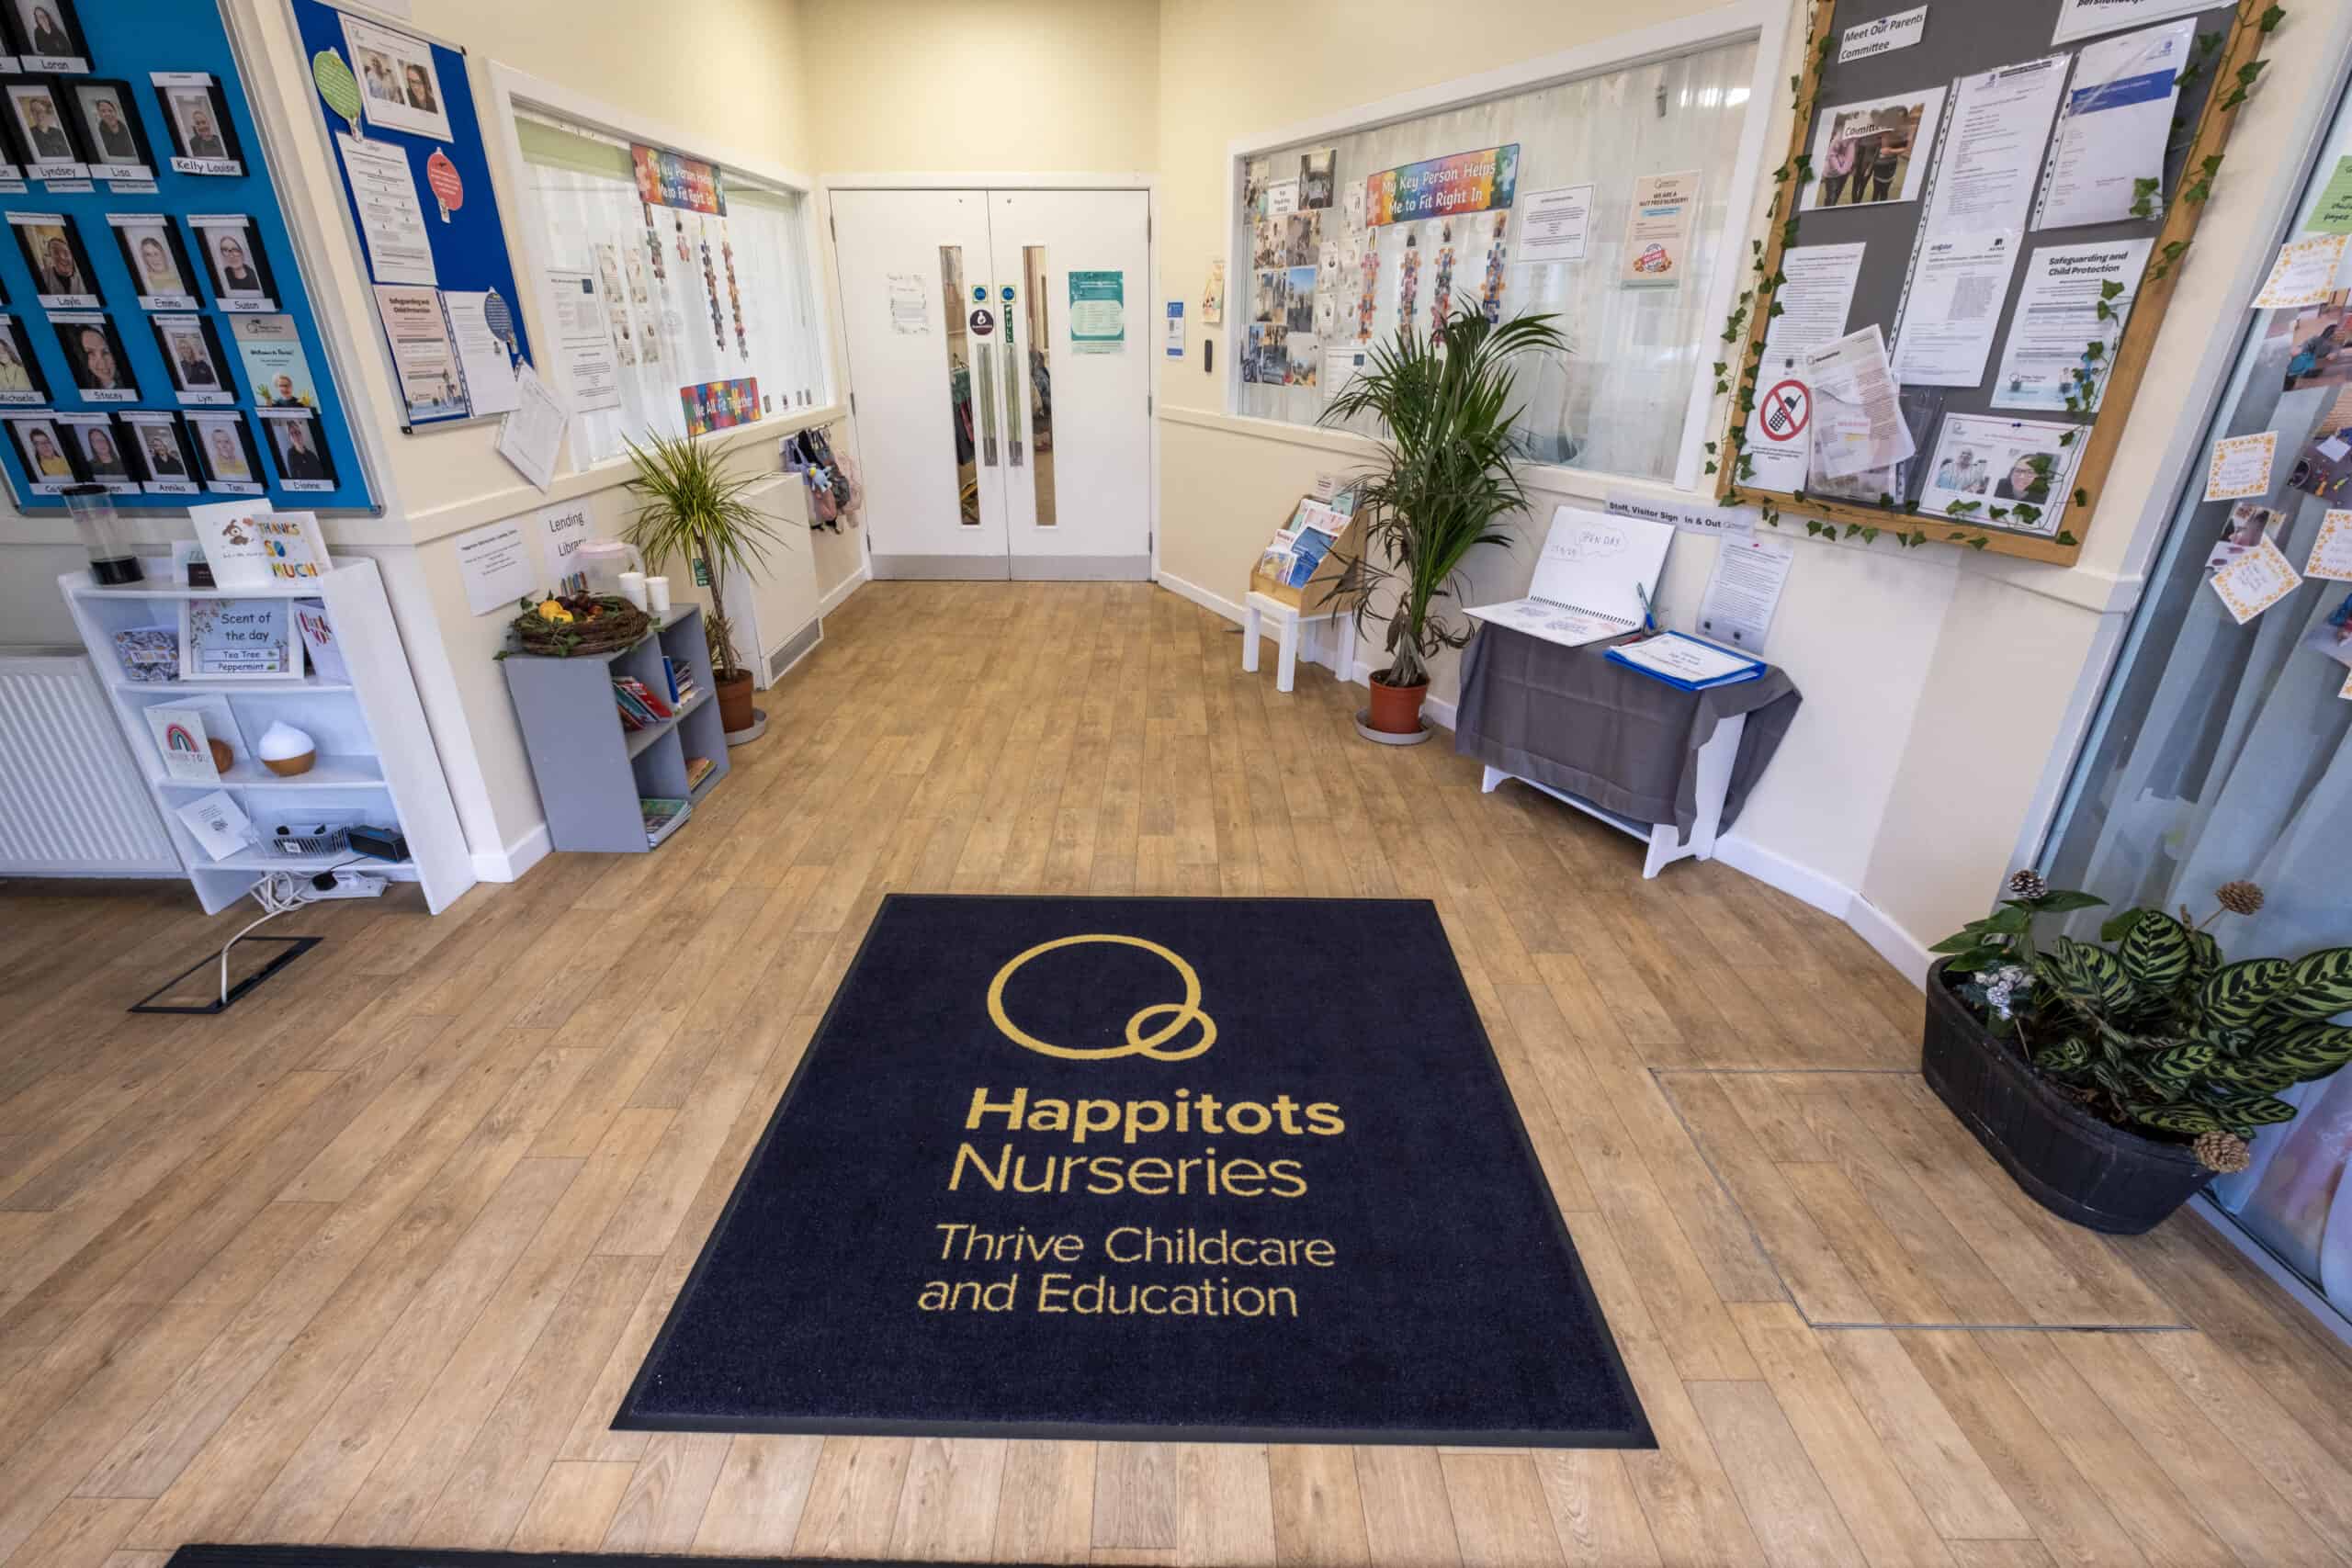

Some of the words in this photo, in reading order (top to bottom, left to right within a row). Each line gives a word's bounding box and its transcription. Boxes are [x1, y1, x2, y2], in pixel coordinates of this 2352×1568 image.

[1845, 28, 1869, 42] Meet
[1871, 24, 1888, 36] Our
[1890, 15, 1923, 30] Parents
[1841, 41, 1890, 60] Committee
[39, 167, 75, 178] Lyndsey
[175, 158, 205, 174] Kelly
[207, 160, 236, 173] Louise
[1382, 182, 1396, 196] My
[1399, 175, 1419, 192] Key
[1423, 168, 1458, 186] Person
[1464, 162, 1496, 177] Helps
[1389, 199, 1403, 214] Me
[1406, 199, 1416, 211] to
[1419, 194, 1432, 209] Fit
[1436, 190, 1466, 209] Right
[1471, 186, 1483, 202] In
[2048, 253, 2108, 266] Safeguarding
[2109, 251, 2129, 262] and
[2048, 266, 2071, 276] Child
[2072, 264, 2120, 275] Protection
[154, 298, 182, 309] Emma
[94, 391, 123, 401] Stacey
[549, 512, 585, 533] Lending
[1610, 502, 1630, 513] Staff,
[1632, 505, 1658, 517] Visitor
[1660, 511, 1679, 522] Sign
[1684, 515, 1693, 524] In
[1694, 516, 1702, 525] &
[1705, 518, 1722, 528] Out
[256, 523, 300, 536] THANKS
[264, 539, 287, 558] SO
[271, 562, 319, 579] MUCH
[220, 613, 254, 625] Scent
[258, 611, 272, 625] of
[225, 630, 245, 641] the
[249, 629, 269, 642] day
[223, 651, 240, 660] Tea
[242, 650, 261, 660] Tree
[218, 662, 265, 672] Peppermint
[965, 1087, 1346, 1144] Happitots
[947, 1143, 1309, 1198] Nurseries
[934, 1223, 1085, 1262] Thrive
[1104, 1226, 1337, 1268] Childcare
[917, 1273, 1018, 1313] and
[1036, 1273, 1299, 1318] Education
